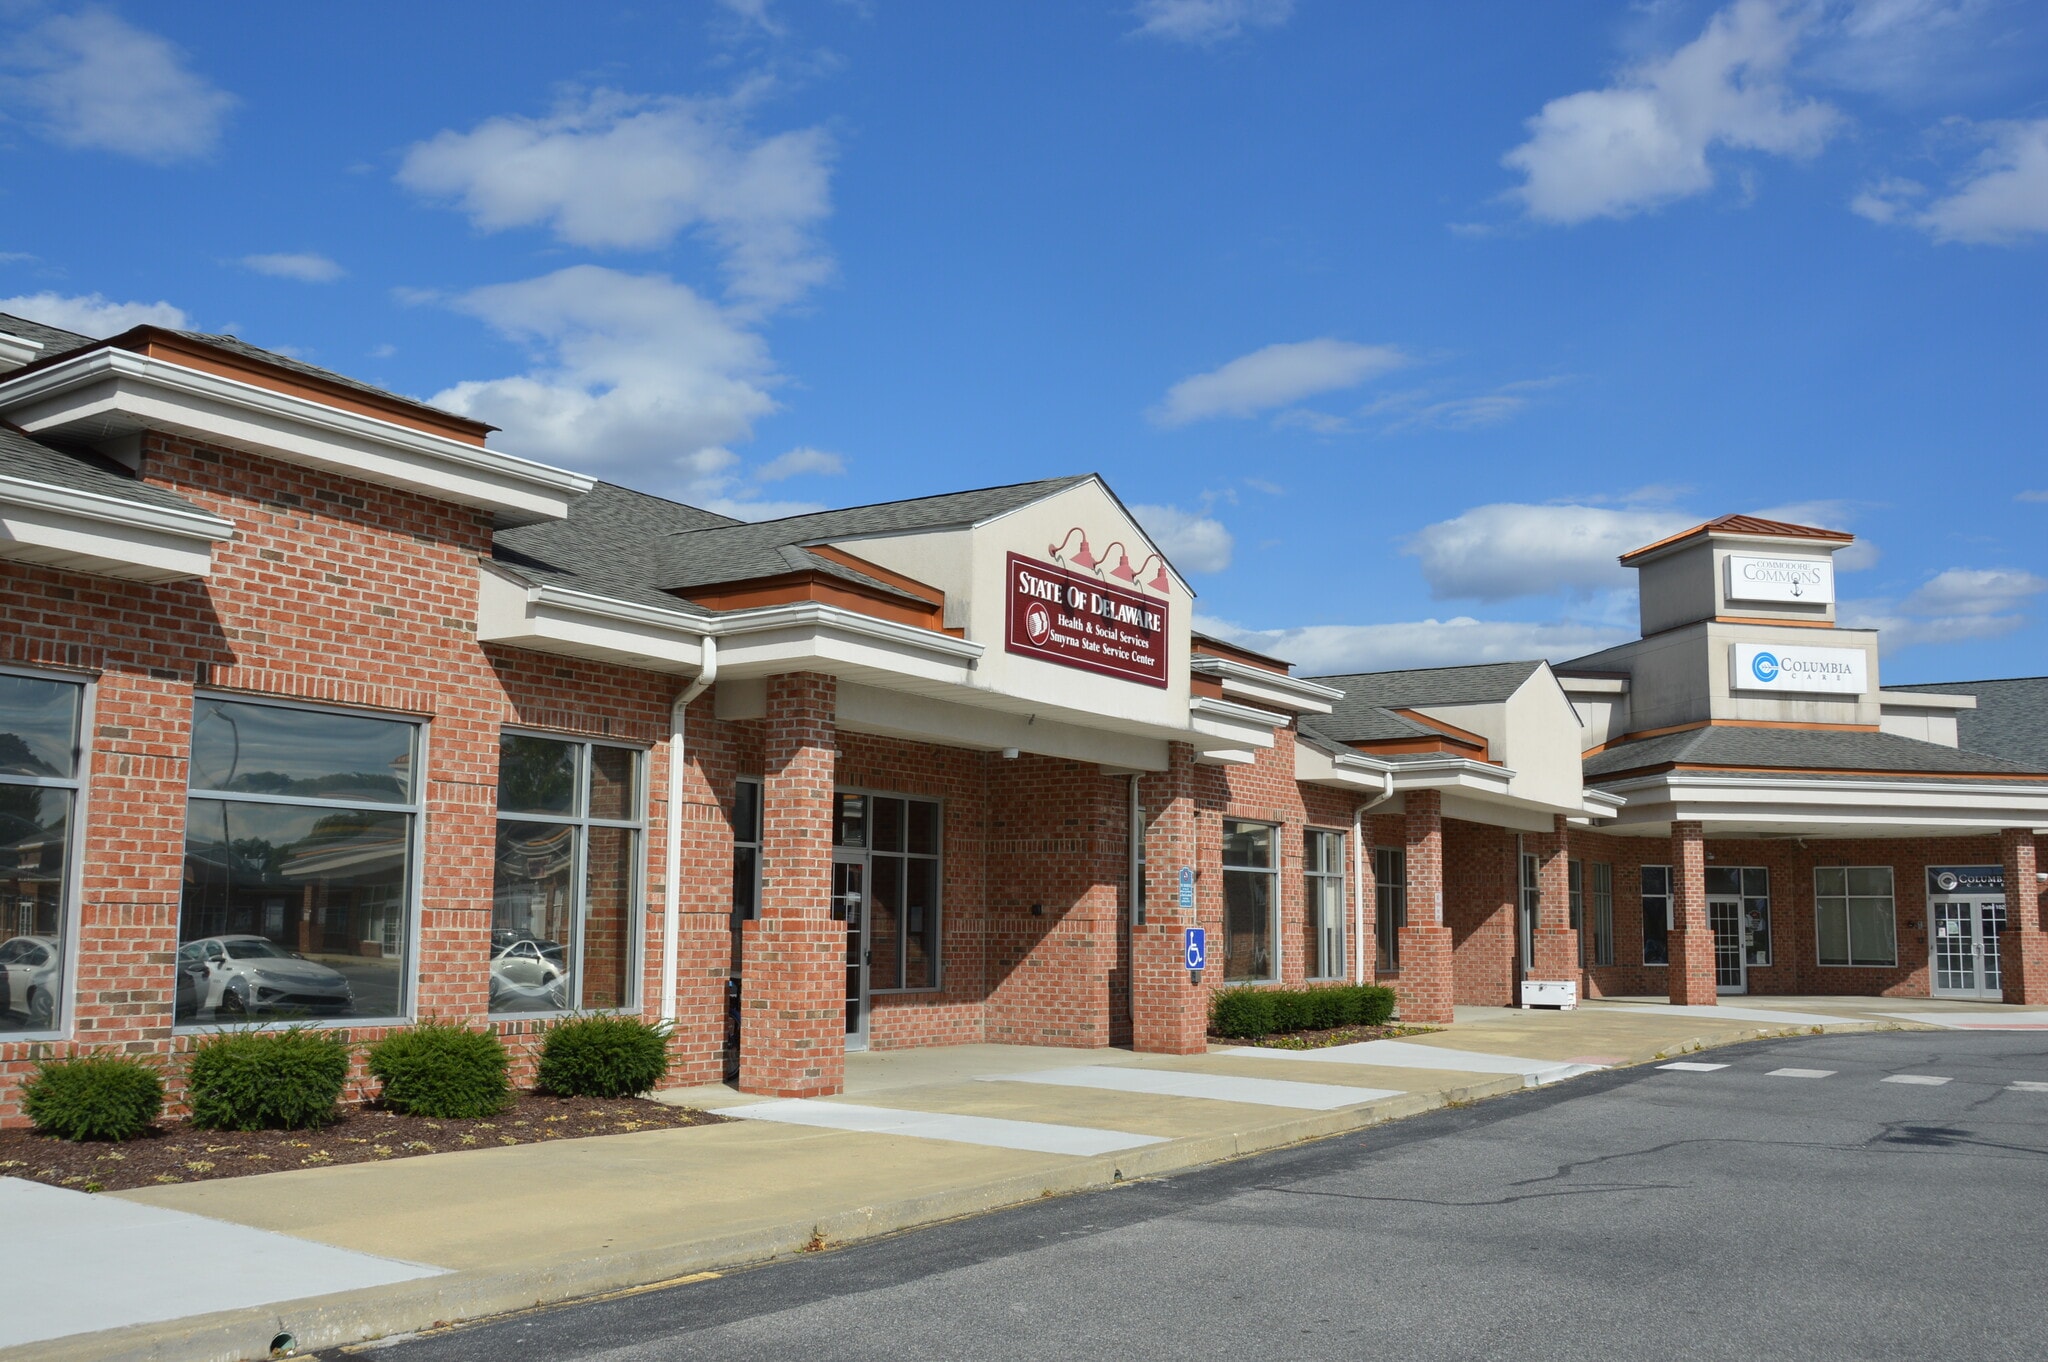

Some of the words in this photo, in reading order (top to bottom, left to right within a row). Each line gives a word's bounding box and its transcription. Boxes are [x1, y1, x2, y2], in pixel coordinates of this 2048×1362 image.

[1743, 563, 1821, 584] COMMONS
[1757, 560, 1811, 571] COMMODORE
[1019, 571, 1063, 604] STATE
[1067, 586, 1087, 610] OF
[1091, 592, 1161, 632] DELAWARE
[1058, 614, 1084, 631] Health
[1085, 622, 1093, 634] &
[1095, 625, 1118, 641] Social
[1120, 631, 1149, 649] Services
[1050, 630, 1080, 648] Smyrna
[1081, 638, 1101, 653] State
[1102, 644, 1130, 660] Service
[1131, 650, 1156, 666] Center
[1781, 657, 1852, 674] COLUMBIA
[1791, 673, 1841, 681] CARE
[1959, 874, 2004, 883] COLUMB
